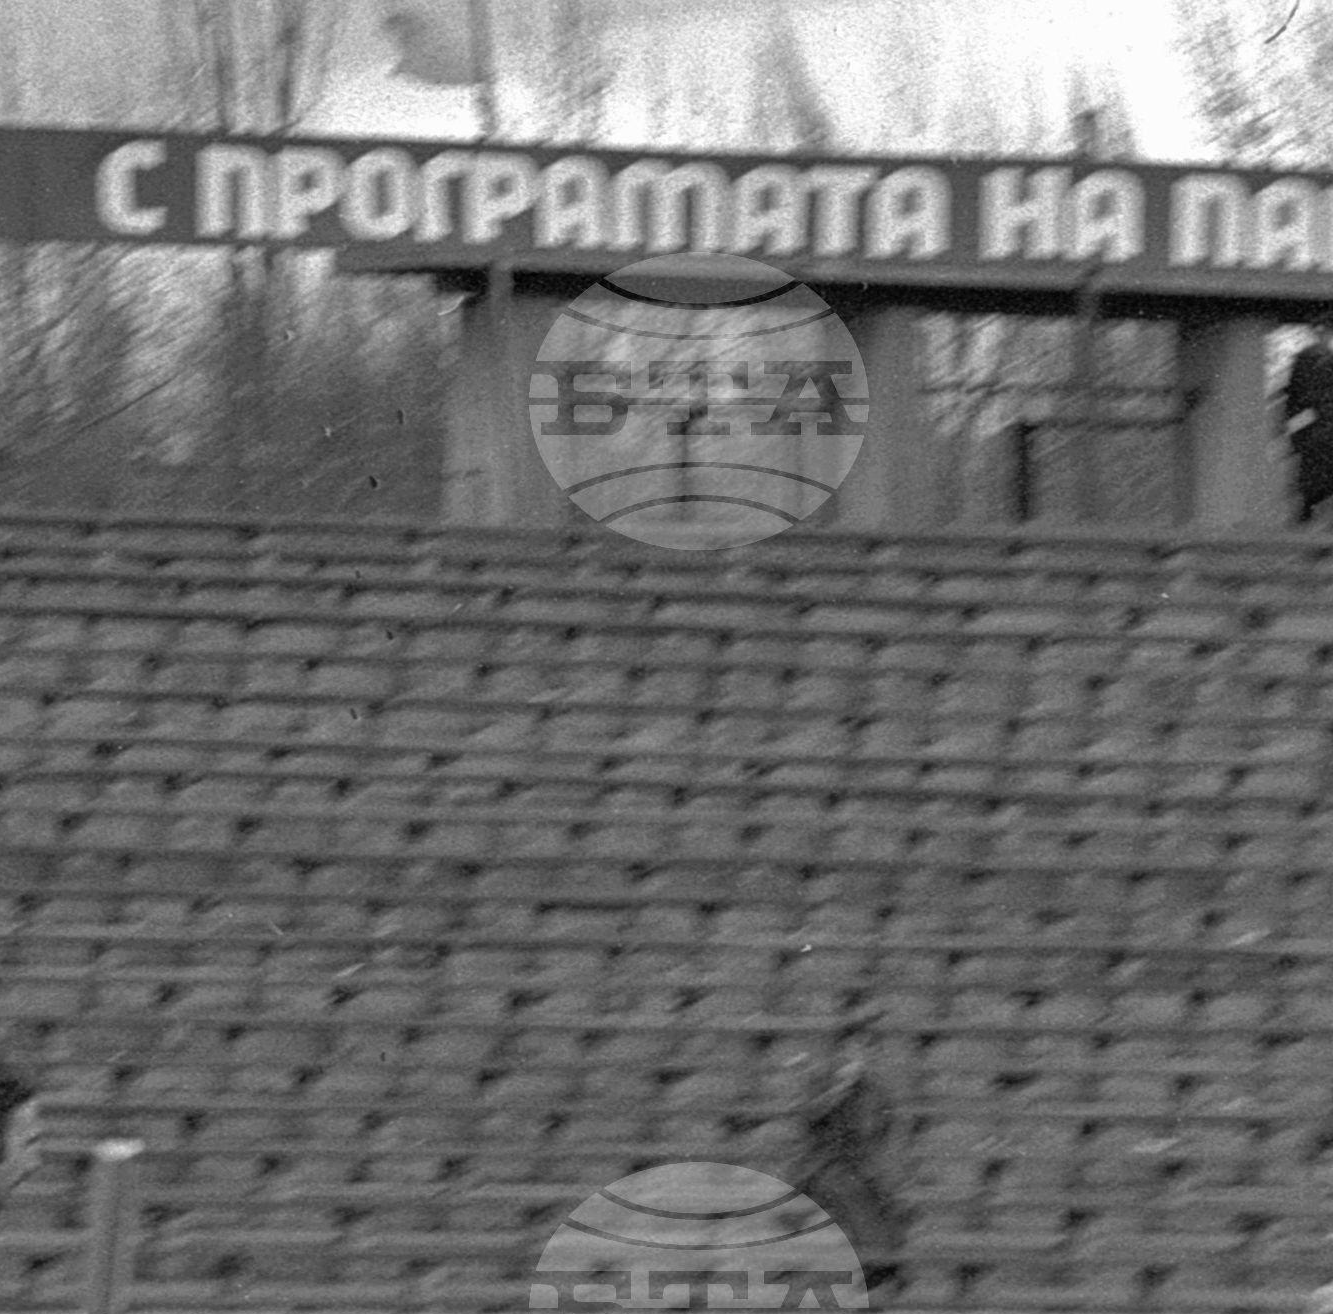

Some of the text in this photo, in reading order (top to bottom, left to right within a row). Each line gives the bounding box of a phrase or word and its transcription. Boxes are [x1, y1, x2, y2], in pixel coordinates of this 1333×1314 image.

[94, 138, 1333, 274] С ПРОГРАМАТА НА ПА
